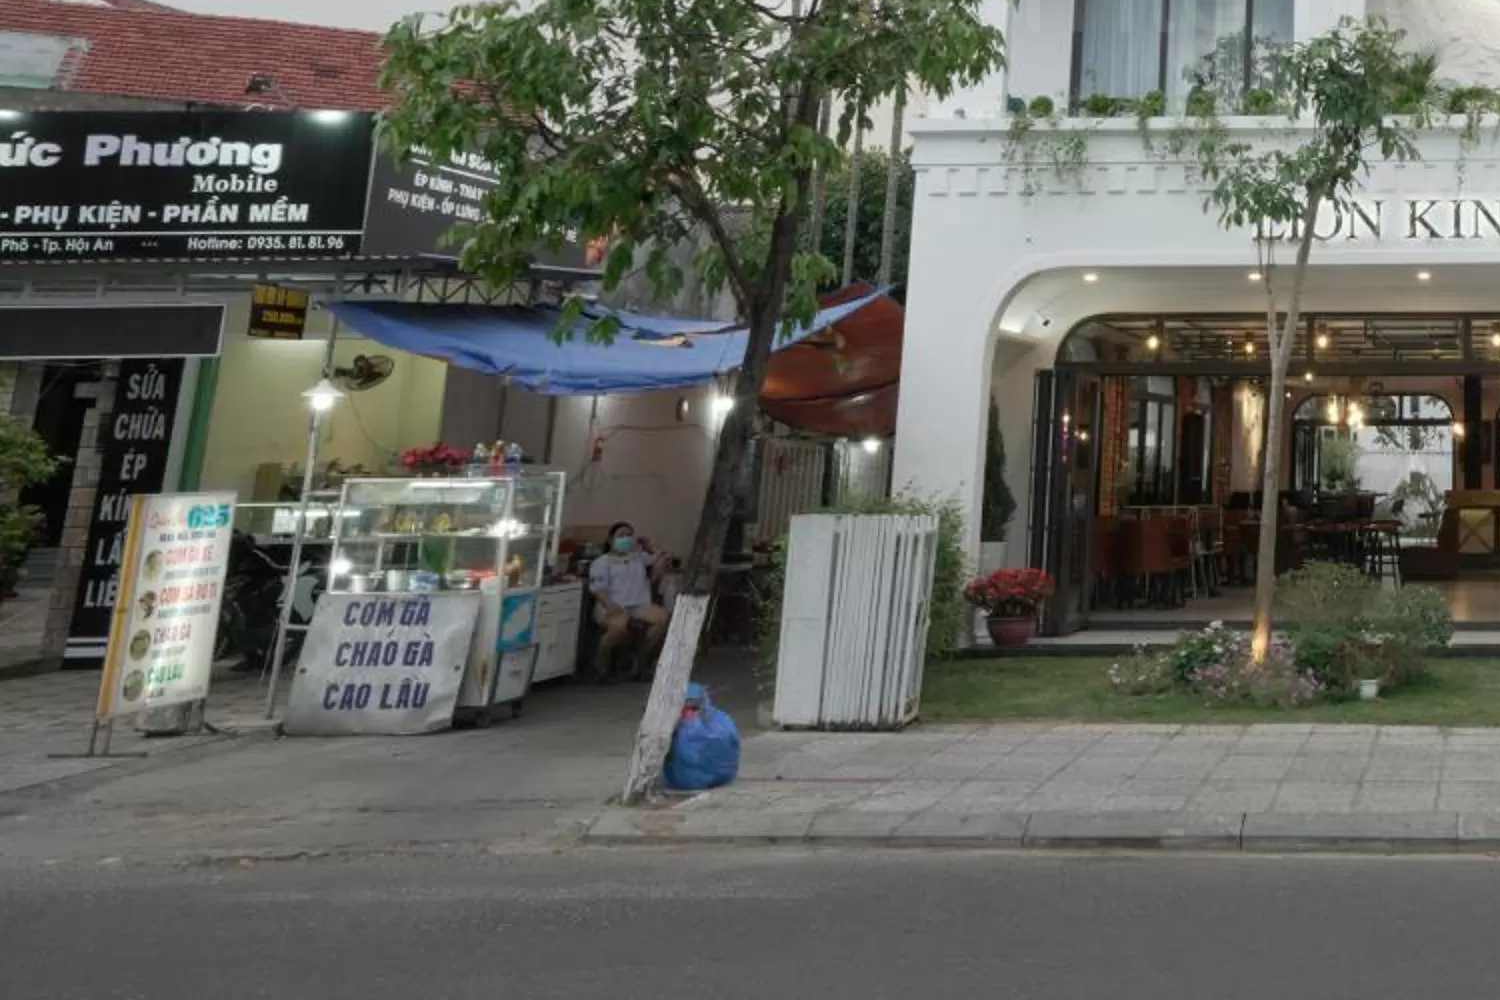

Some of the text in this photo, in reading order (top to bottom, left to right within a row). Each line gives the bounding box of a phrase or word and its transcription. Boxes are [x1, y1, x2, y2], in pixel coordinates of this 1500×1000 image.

[84, 134, 284, 174] Phương
[192, 174, 279, 193] Mobile
[14, 205, 69, 231] PHỤ
[78, 200, 141, 229] KIỆN
[120, 450, 148, 481] ÉP
[402, 632, 435, 666] GÀ
[323, 683, 371, 710] CAO
